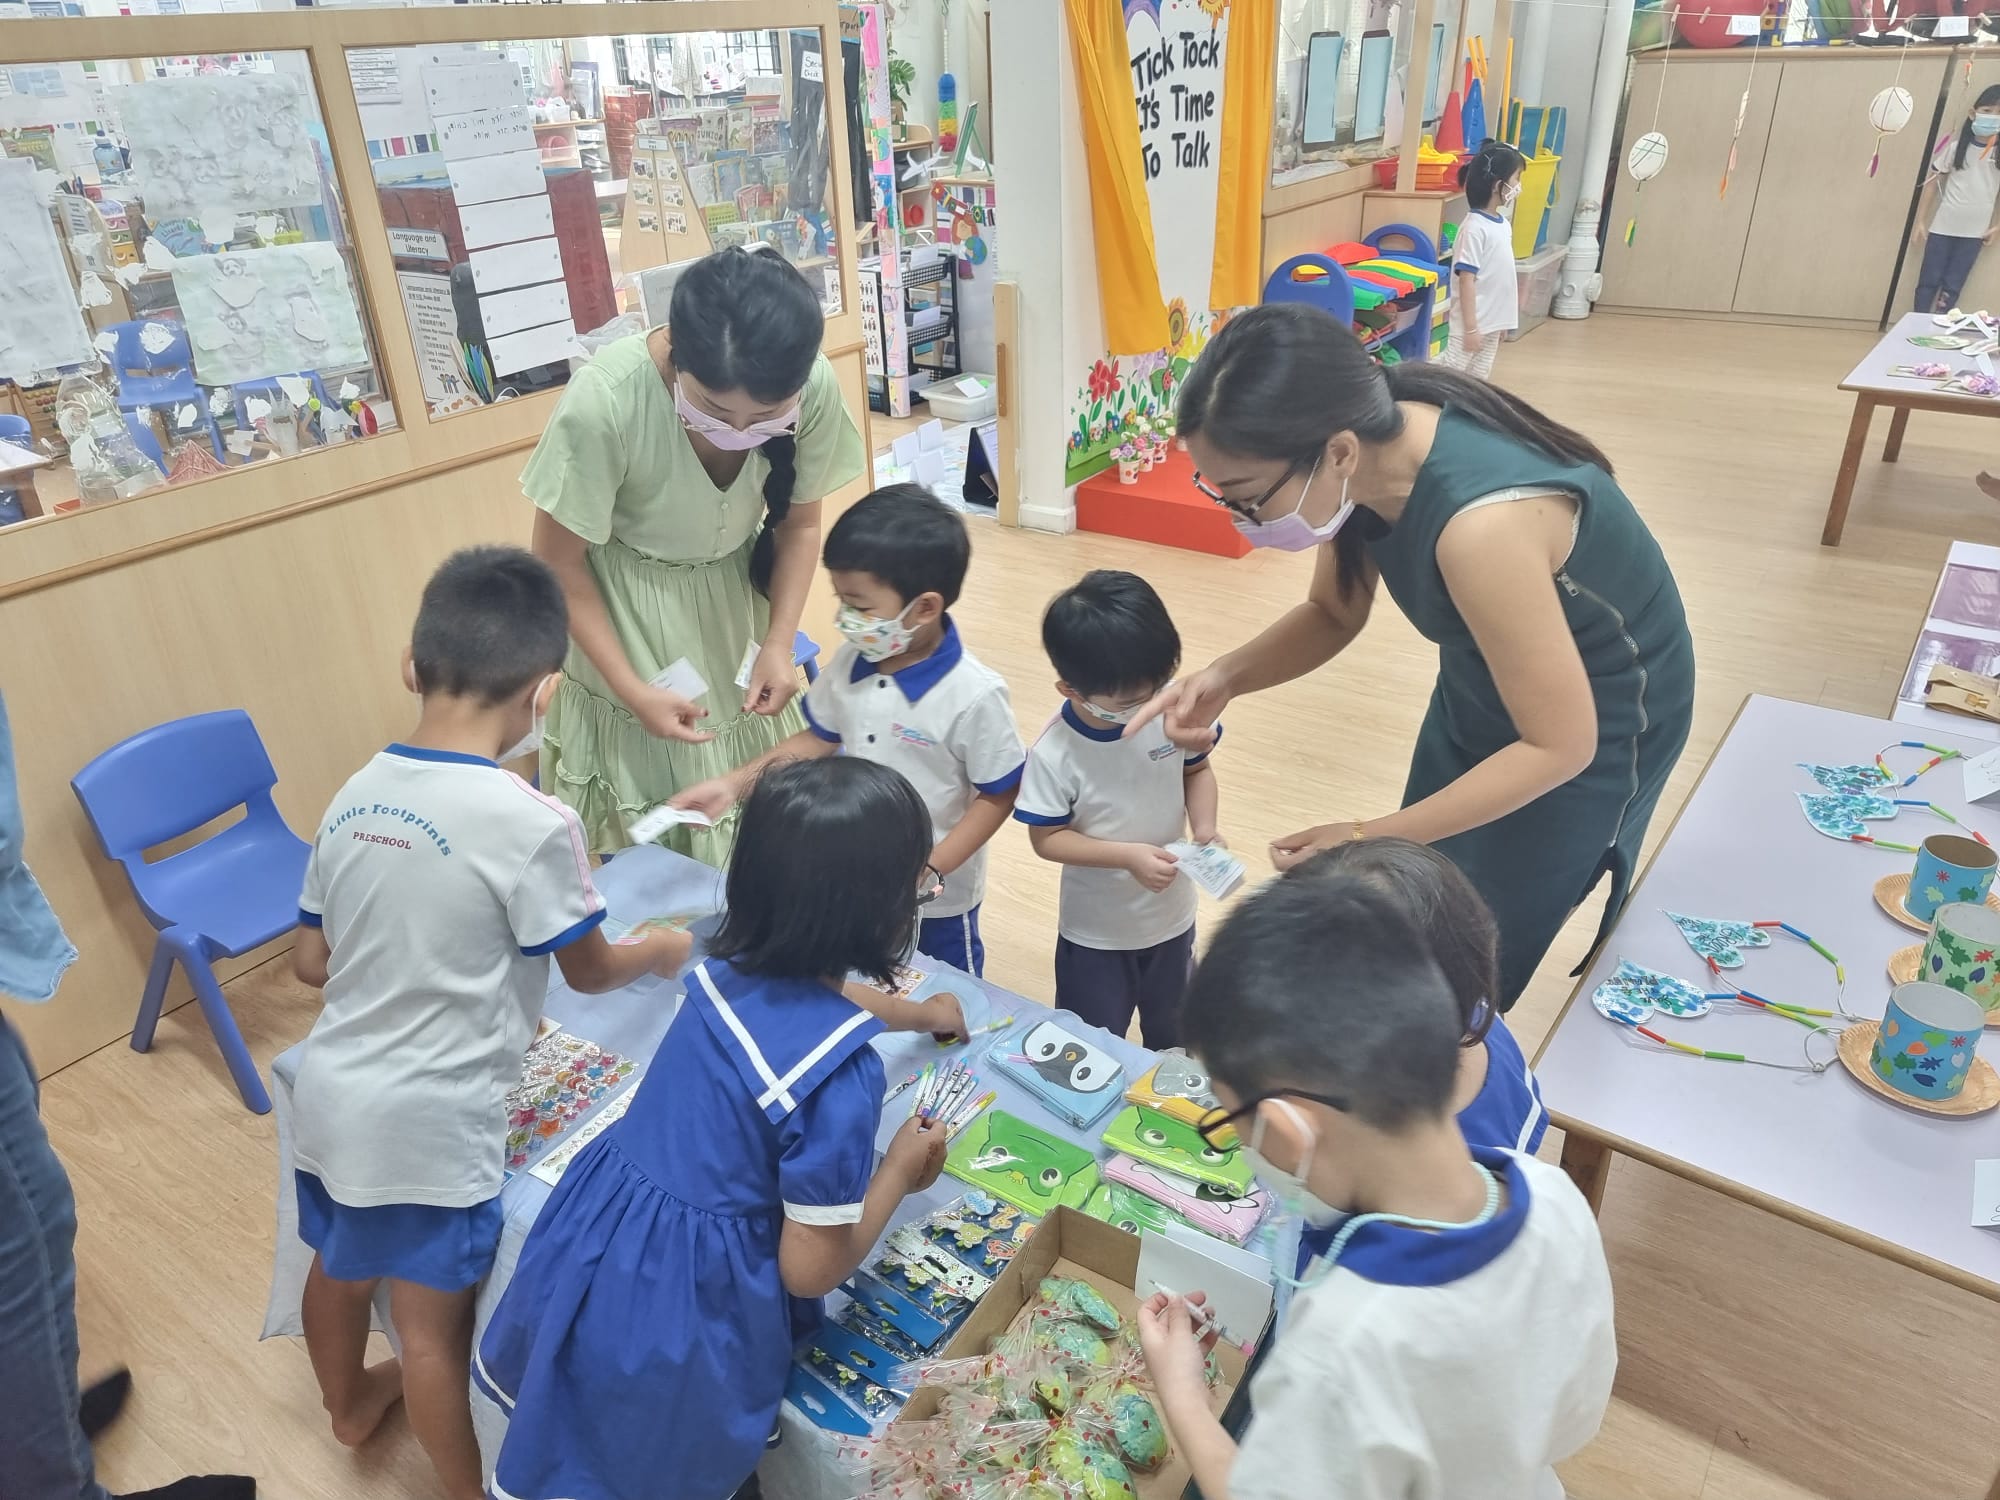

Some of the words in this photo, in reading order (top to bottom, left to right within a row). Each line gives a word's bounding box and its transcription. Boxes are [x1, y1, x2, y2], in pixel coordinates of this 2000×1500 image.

[1130, 37, 1174, 91] Tick
[1179, 29, 1219, 68] Tock
[1170, 84, 1214, 122] Time
[1141, 143, 1160, 181] To
[1171, 131, 1210, 168] Talk
[392, 232, 423, 243] Language
[424, 235, 437, 243] and
[405, 244, 429, 256] Literacy
[328, 806, 366, 834] Little
[372, 804, 451, 856] Footprints
[353, 831, 412, 850] PRESCHOOL
